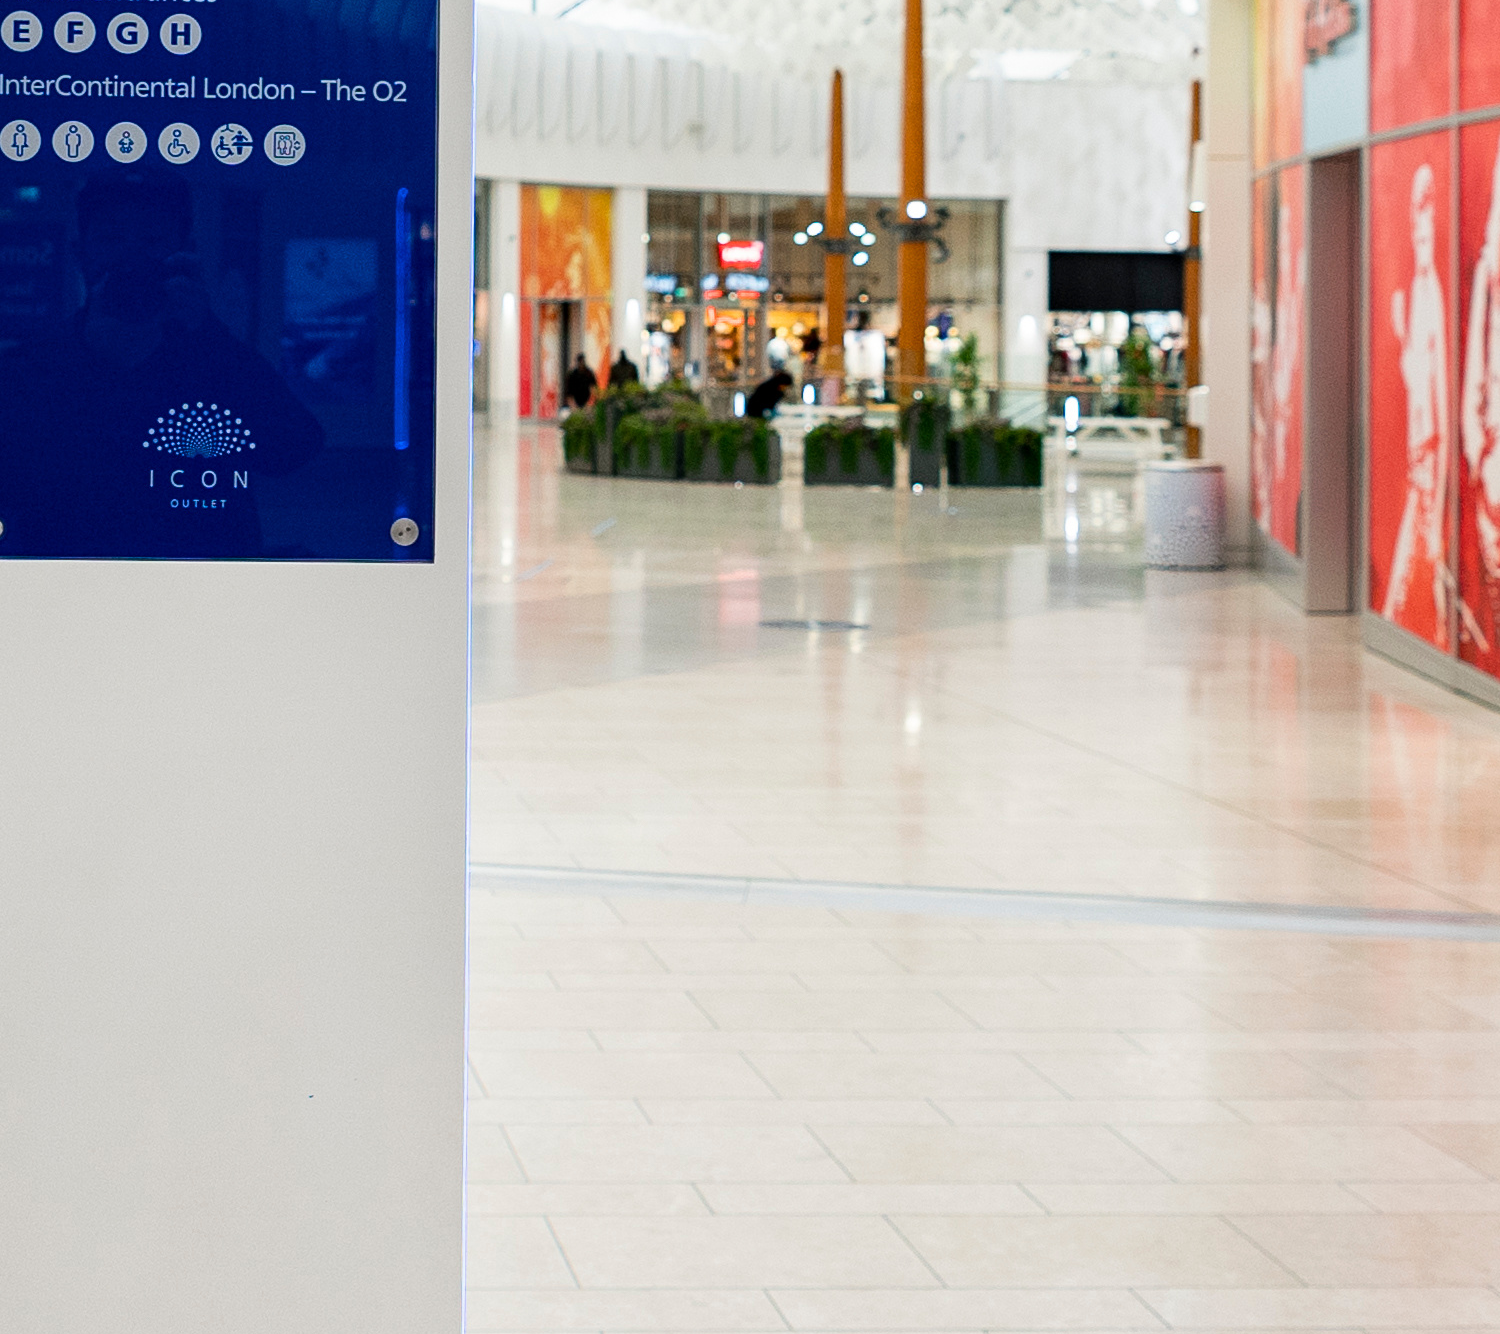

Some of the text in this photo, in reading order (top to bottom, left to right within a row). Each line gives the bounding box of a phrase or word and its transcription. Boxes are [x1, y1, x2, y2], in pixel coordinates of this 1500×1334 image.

[13, 19, 192, 46] E F G H
[0, 73, 196, 99] InterContinental
[203, 77, 295, 100] London
[320, 78, 366, 101] The
[372, 80, 407, 102] O2
[149, 469, 248, 489] ICON
[170, 498, 227, 509] OUTLET
